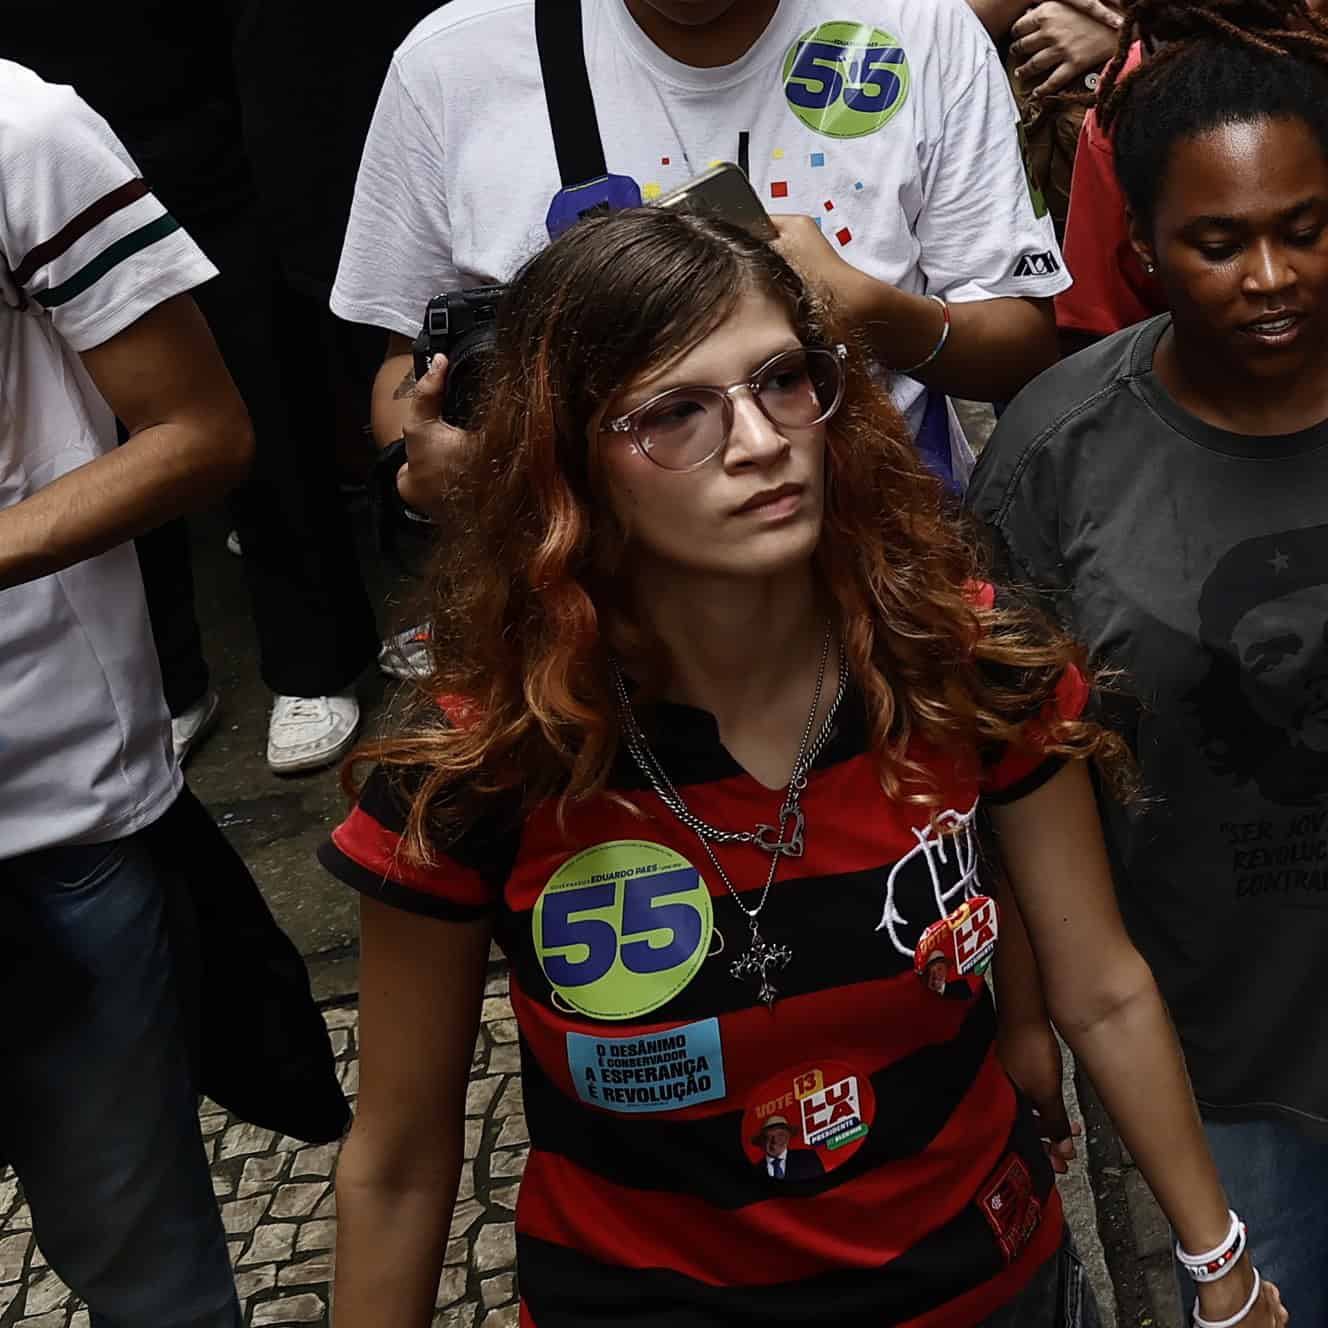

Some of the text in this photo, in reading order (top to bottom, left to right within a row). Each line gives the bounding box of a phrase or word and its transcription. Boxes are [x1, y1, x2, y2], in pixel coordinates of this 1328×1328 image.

[786, 41, 905, 112] 55
[591, 869, 634, 883] EDUARDO
[635, 863, 658, 875] PAES
[542, 867, 702, 988] 55
[596, 1034, 687, 1058] O DESÂNIMO
[607, 1049, 687, 1069] CONSERVADOR
[585, 1056, 709, 1085] A ESPERANÇA
[795, 1073, 818, 1096] 13
[588, 1074, 712, 1105] É REVOLUÇÃO
[803, 1080, 851, 1117] LU
[756, 1095, 794, 1119] VOTE
[804, 1100, 855, 1136] LA
